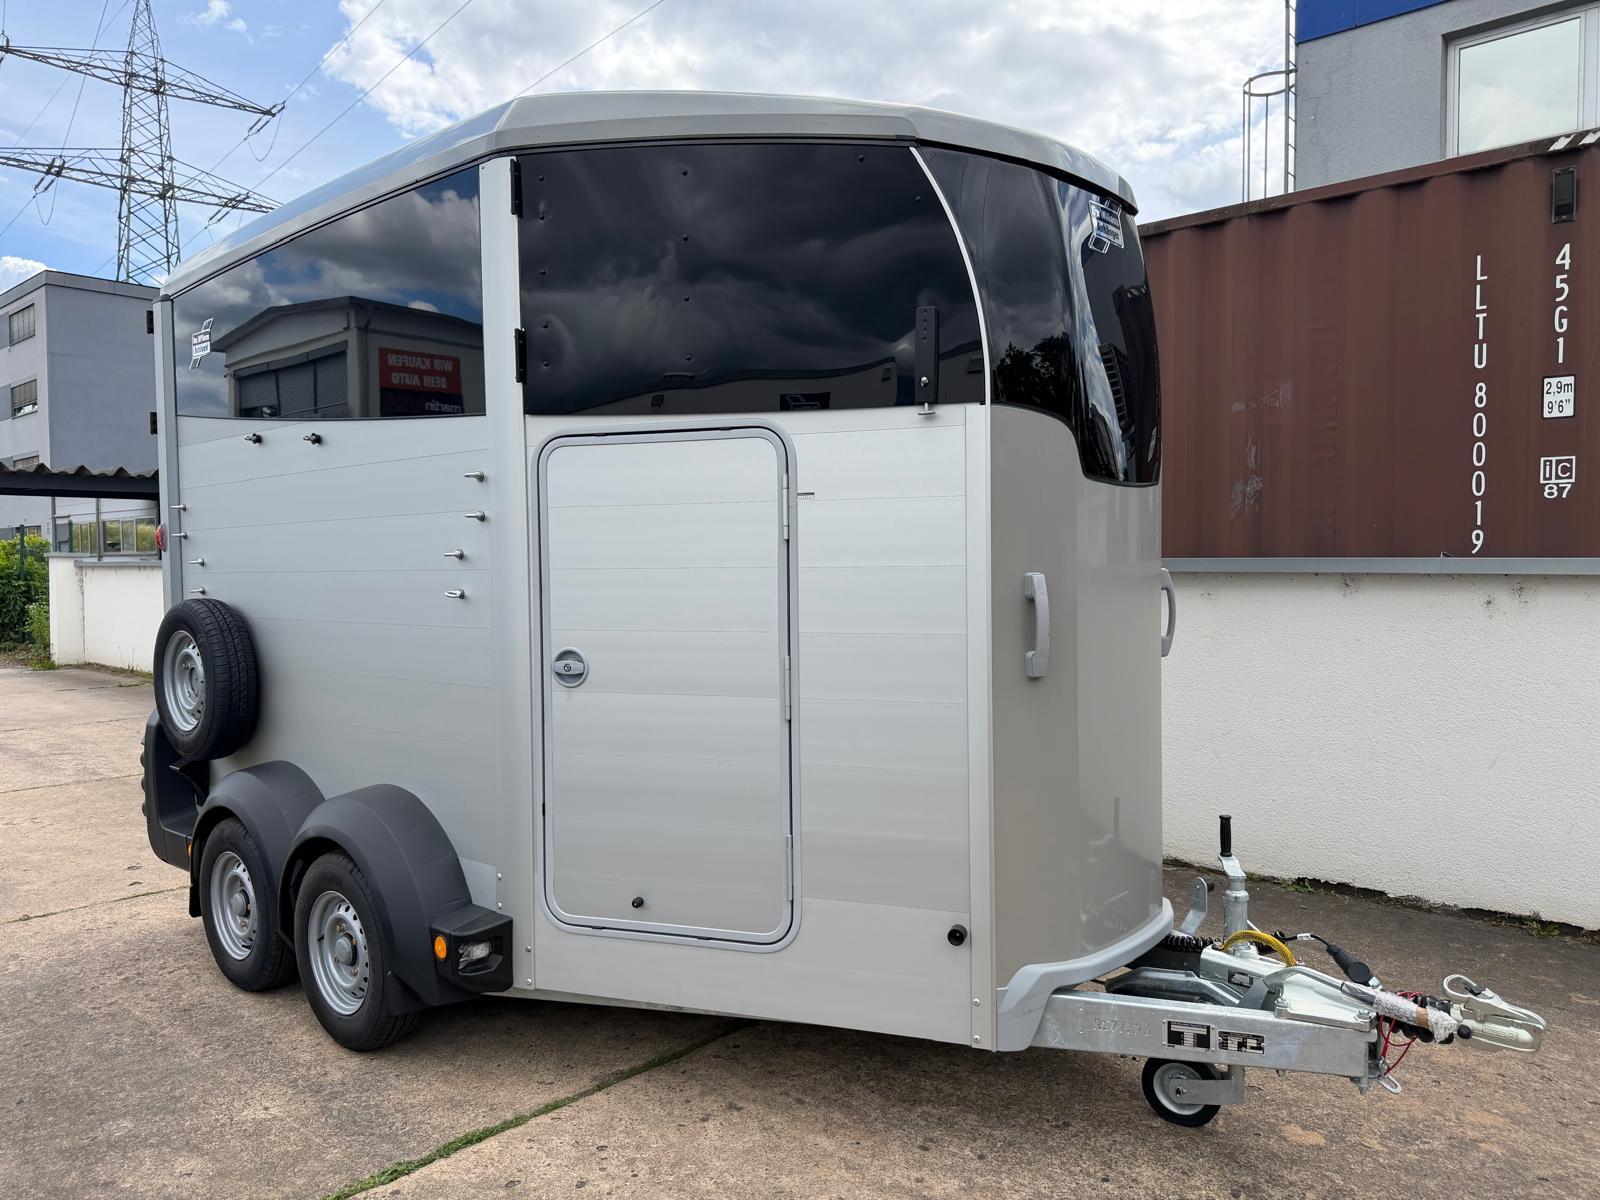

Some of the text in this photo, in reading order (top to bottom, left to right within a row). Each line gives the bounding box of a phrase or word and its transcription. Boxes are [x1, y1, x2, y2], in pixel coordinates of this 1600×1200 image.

[1553, 243, 1571, 364] 45G1
[1471, 254, 1488, 555] LLTU 800019
[1543, 483, 1572, 499] 87
